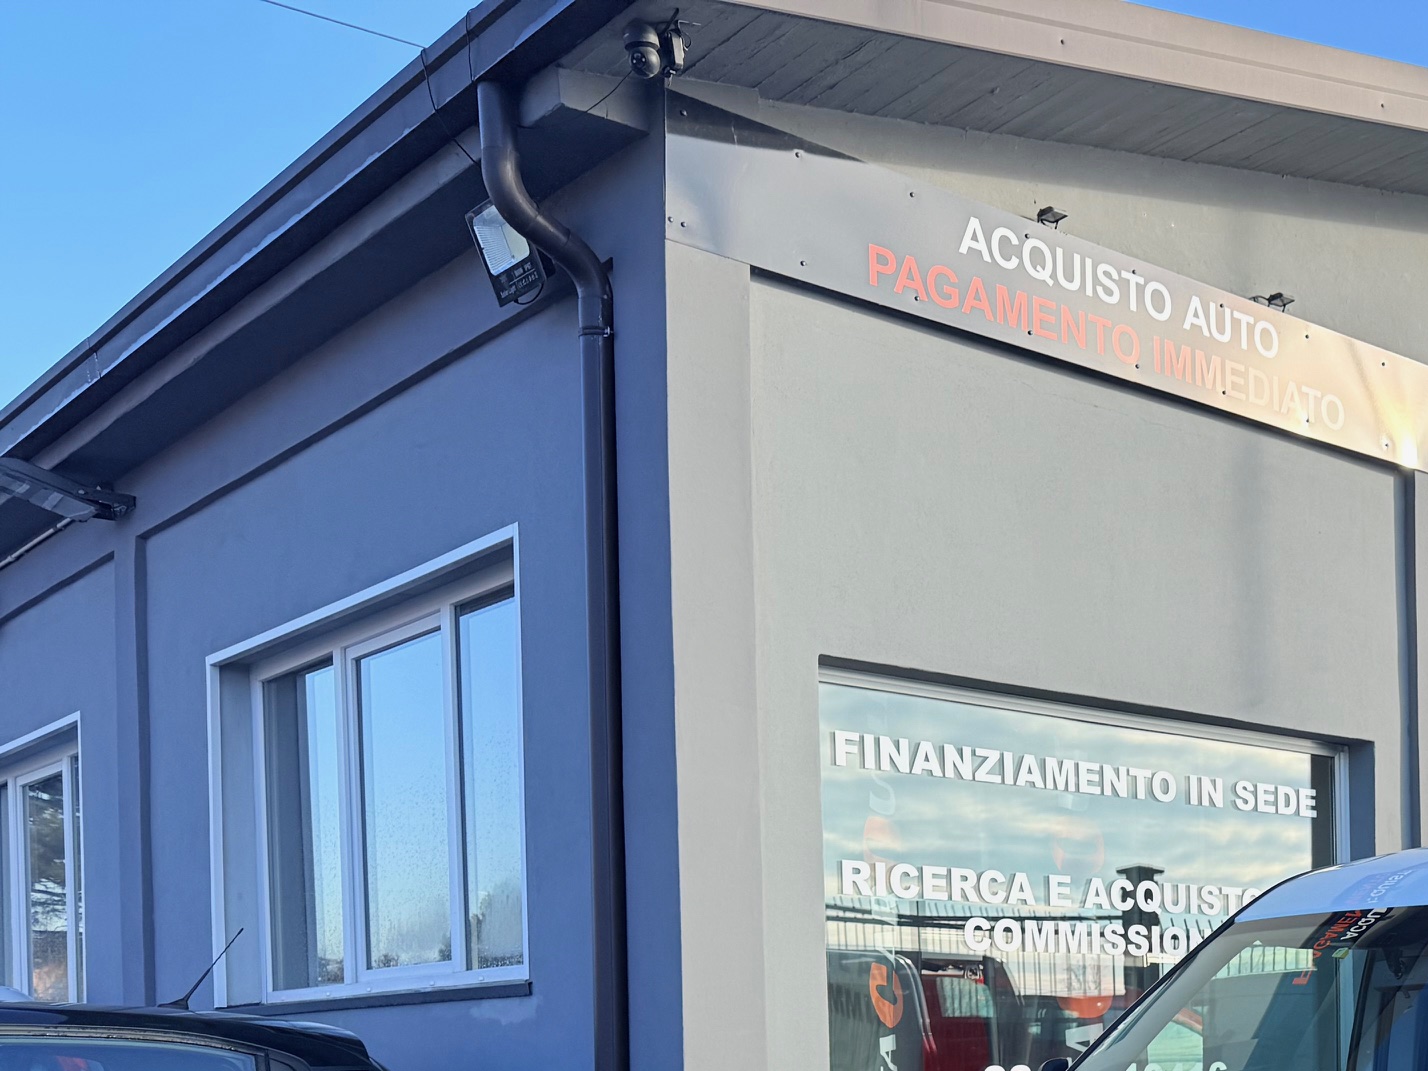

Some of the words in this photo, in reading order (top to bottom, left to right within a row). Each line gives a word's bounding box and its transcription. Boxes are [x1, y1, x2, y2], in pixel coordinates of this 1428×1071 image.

[867, 243, 1140, 365] PAGAMENTO
[1152, 335, 1345, 430] IMMEDIATO
[958, 216, 1173, 321] ACQUISTO
[1183, 296, 1280, 359] AUTO
[833, 729, 1177, 802] FINANZIAMENTO
[1189, 775, 1224, 807] IN
[1233, 780, 1318, 818] SEDE
[841, 859, 1036, 906] RICERCA
[1048, 875, 1072, 909] E
